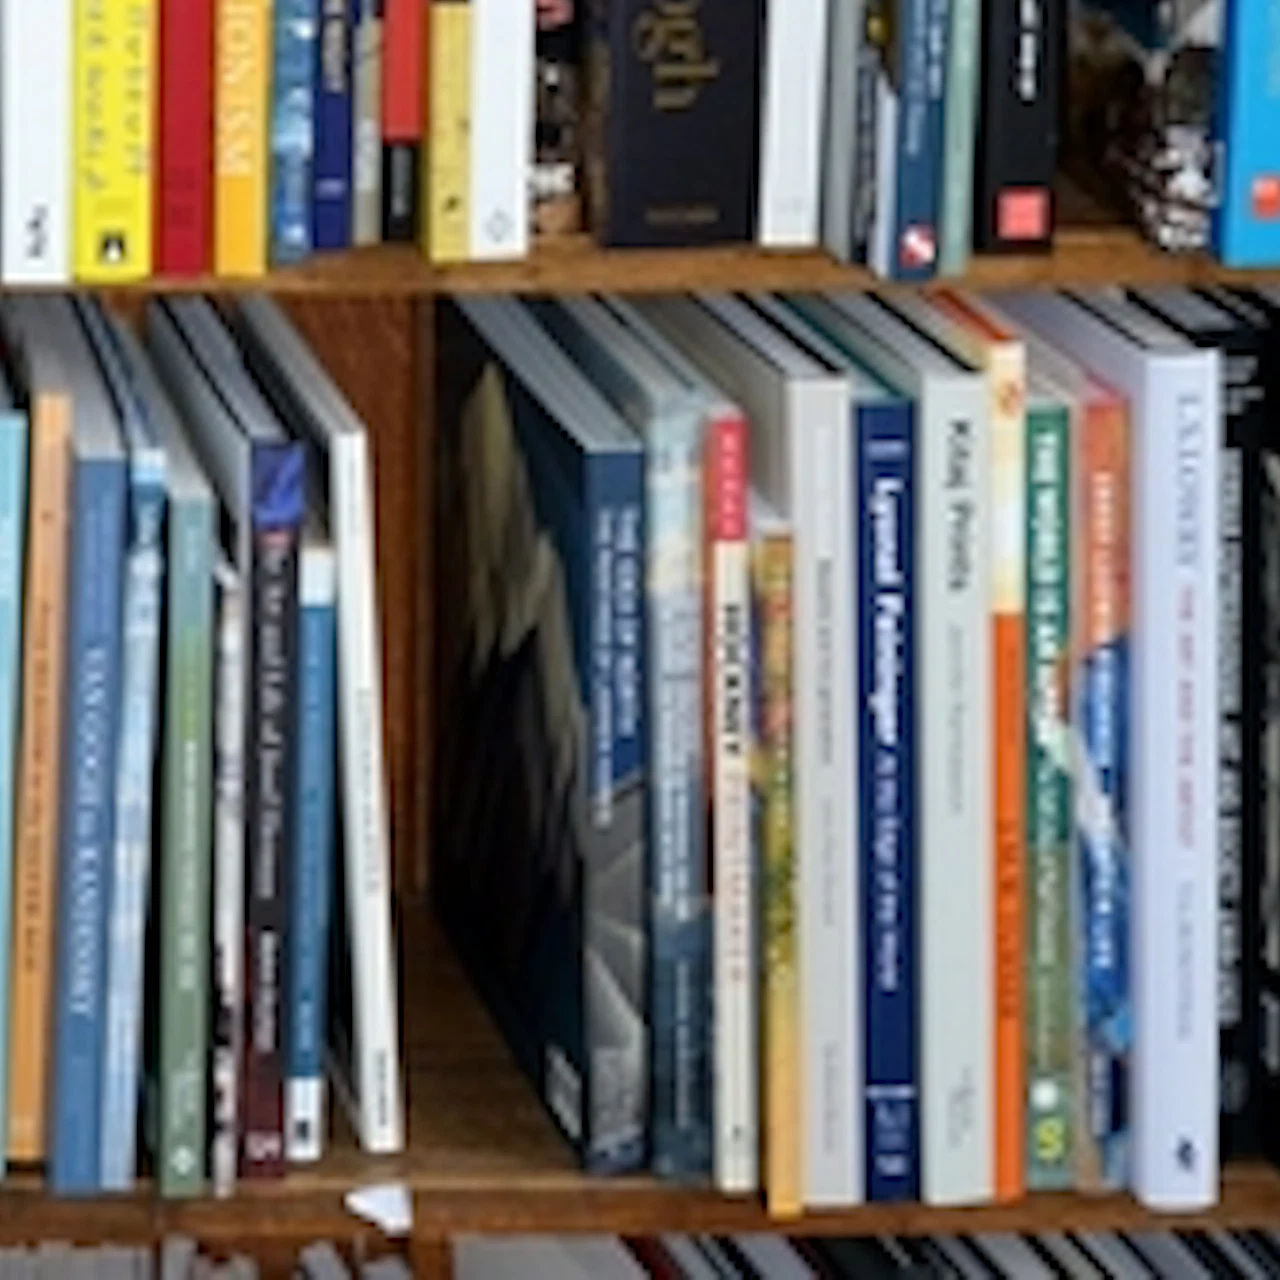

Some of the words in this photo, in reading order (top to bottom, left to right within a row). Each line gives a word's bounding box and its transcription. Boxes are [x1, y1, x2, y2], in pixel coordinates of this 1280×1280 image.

[940, 419, 973, 490] Kitaj
[870, 478, 906, 586] Lyonel
[945, 500, 973, 591] Prints
[1033, 489, 1061, 582] WORLD
[83, 646, 108, 708] VAN
[262, 624, 286, 666] and
[722, 601, 743, 757] HOCKNEY
[872, 593, 906, 746] Feininger
[1033, 620, 1058, 660] AN
[259, 670, 287, 713] Life
[76, 709, 104, 805] GOGH
[67, 843, 101, 1021] KANDINSKY
